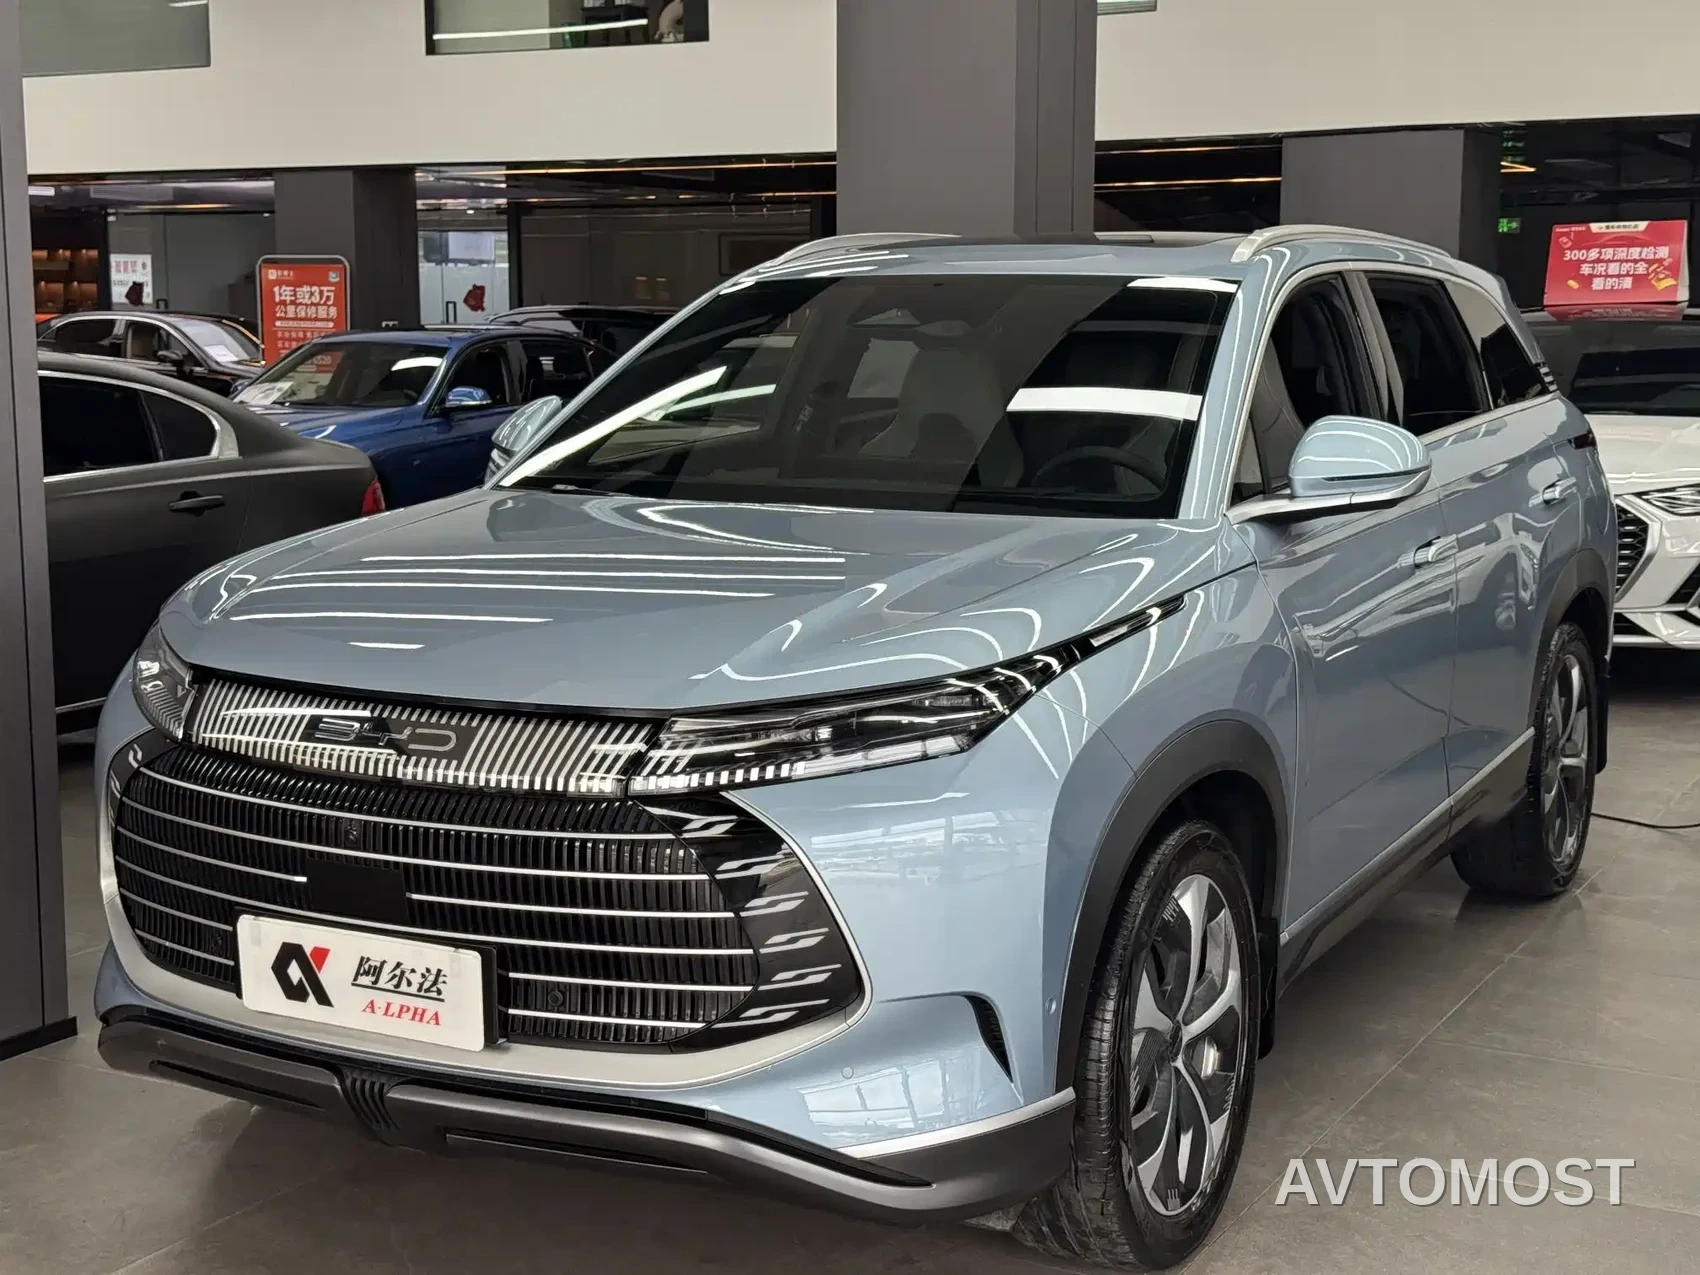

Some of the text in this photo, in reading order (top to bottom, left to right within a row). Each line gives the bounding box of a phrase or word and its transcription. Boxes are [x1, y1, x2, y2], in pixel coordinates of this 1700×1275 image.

[1579, 262, 1648, 276] 车况看的全
[273, 284, 336, 305] 1年或3万
[275, 304, 338, 319] 公里保修服务
[353, 955, 448, 997] 阿尔法
